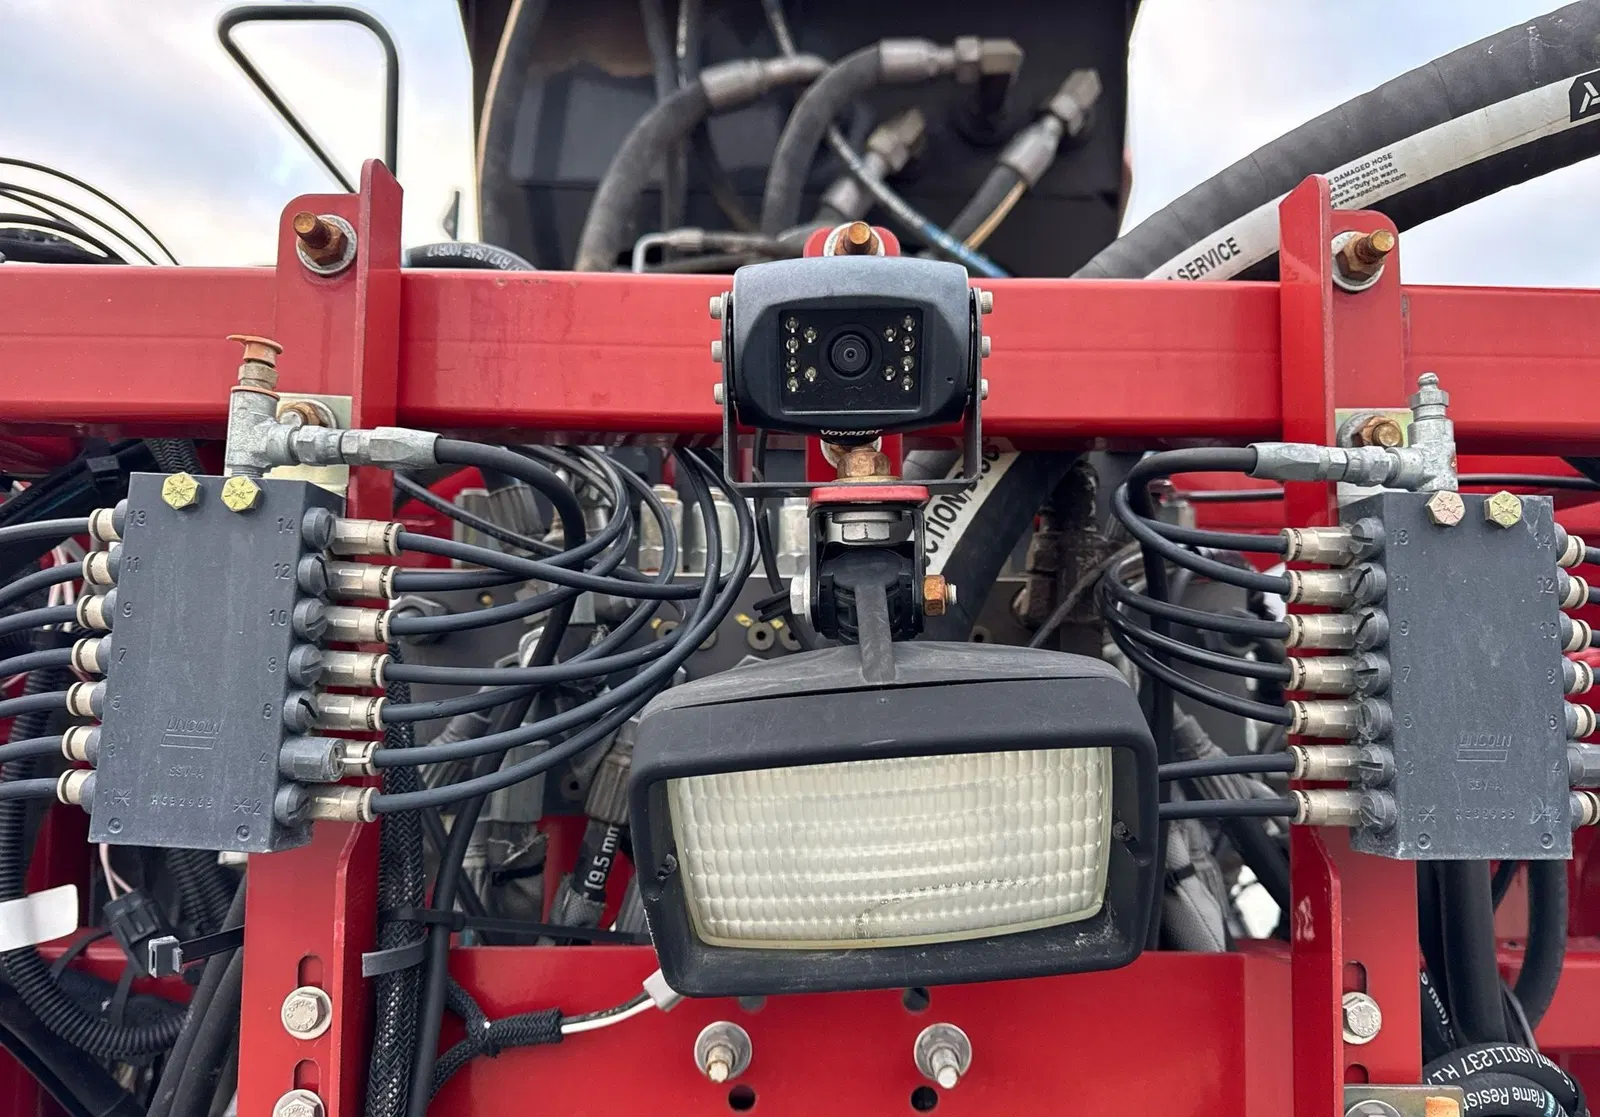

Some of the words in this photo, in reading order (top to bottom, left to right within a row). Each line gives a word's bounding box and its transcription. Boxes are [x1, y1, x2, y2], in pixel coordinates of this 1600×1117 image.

[1334, 162, 1370, 183] DAMAGED
[1372, 152, 1392, 166] HOSE
[1337, 176, 1360, 190] before
[1362, 168, 1378, 178] each
[1380, 162, 1392, 171] use
[1380, 168, 1398, 178] warn
[1177, 237, 1241, 281] SERVICE
[128, 510, 147, 527] 13
[277, 518, 295, 534] 14
[125, 557, 140, 573] 11
[273, 564, 291, 580] 12
[1537, 578, 1555, 594] 12
[122, 603, 132, 618] 9
[269, 610, 288, 627] 10
[1400, 620, 1410, 636] 9
[117, 649, 127, 664] 7
[267, 657, 277, 673] 8
[1402, 667, 1411, 682] 7
[1546, 669, 1556, 684] 8
[263, 703, 273, 720] 6
[1548, 713, 1558, 730] 6
[166, 716, 222, 735] LINCOLN
[1459, 731, 1512, 747] LINCOLN
[259, 752, 269, 765] 4
[584, 855, 610, 891] (9.5
[1513, 1086, 1545, 1109] Flame
